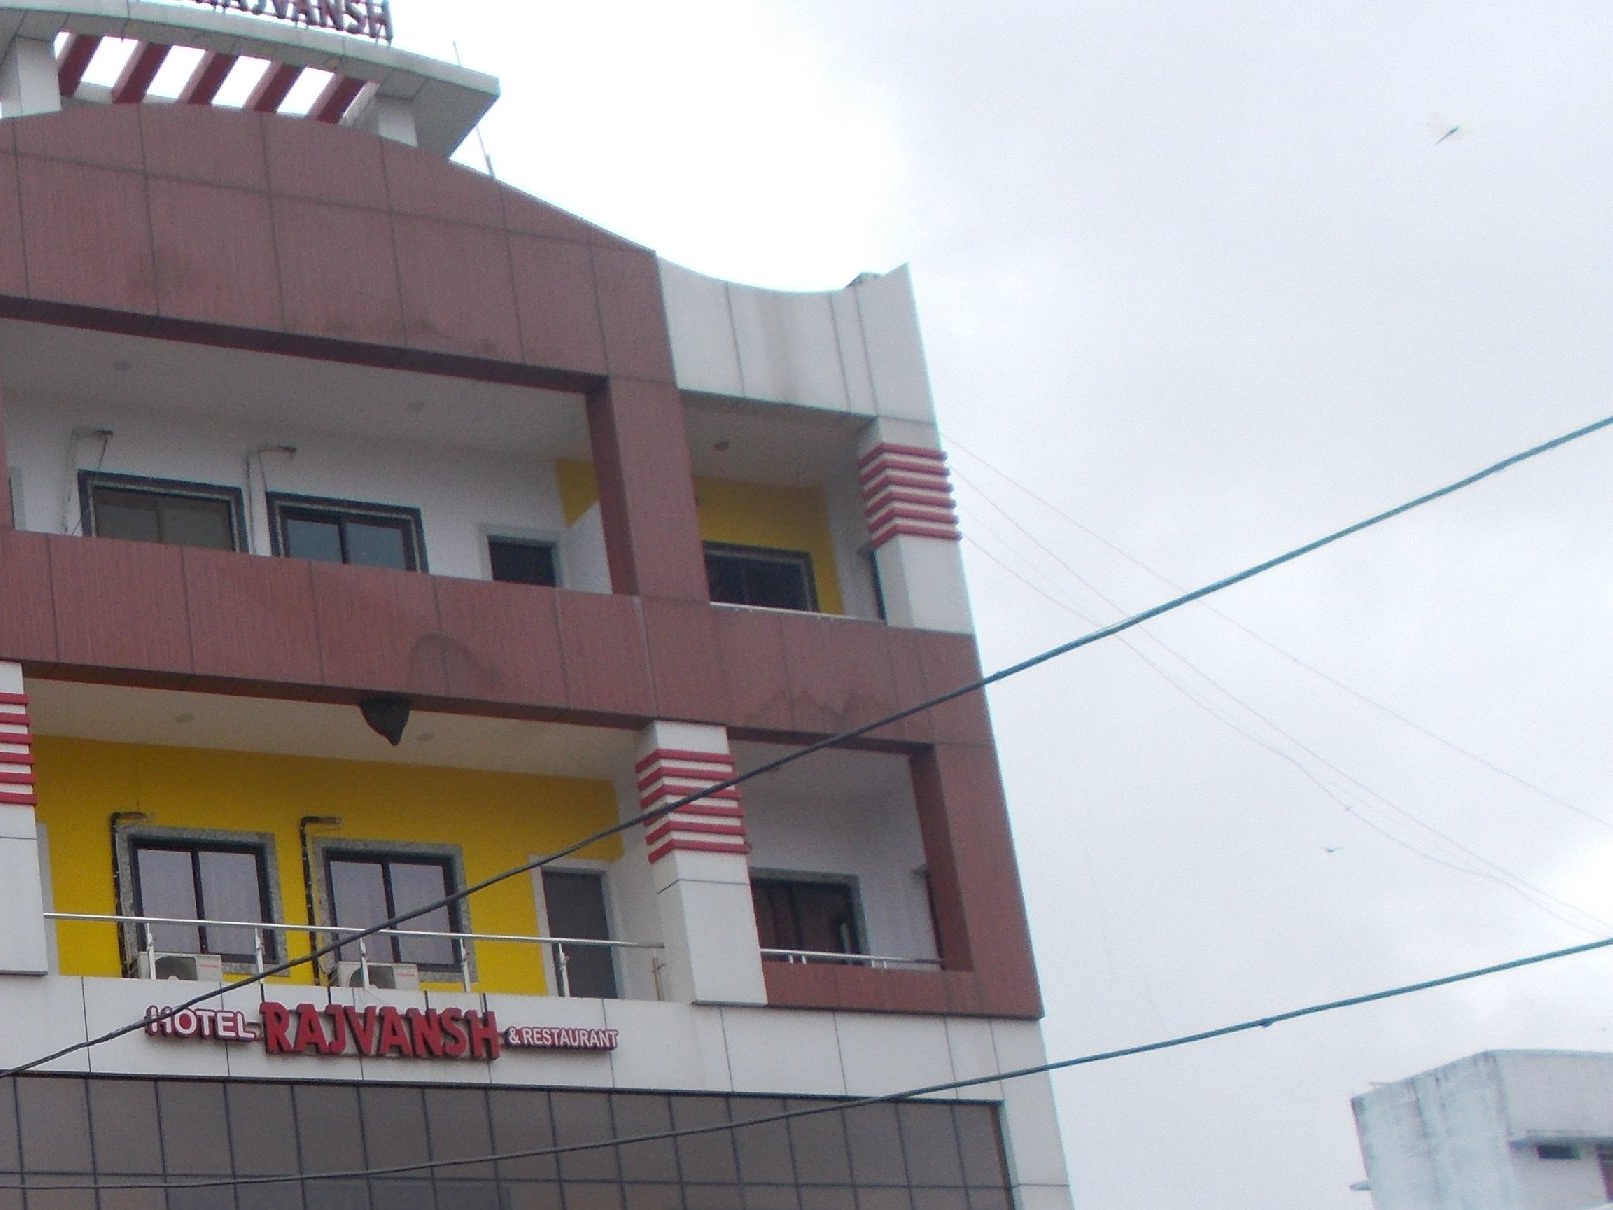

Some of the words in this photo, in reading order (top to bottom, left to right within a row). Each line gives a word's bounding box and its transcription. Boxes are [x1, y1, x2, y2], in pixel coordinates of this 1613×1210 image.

[194, 0, 393, 43] VANSH
[145, 1005, 255, 1041] HOTEL
[259, 1001, 500, 1060] RAJVANSH
[507, 1026, 520, 1046] &
[521, 1027, 618, 1050] RESTAURANT
